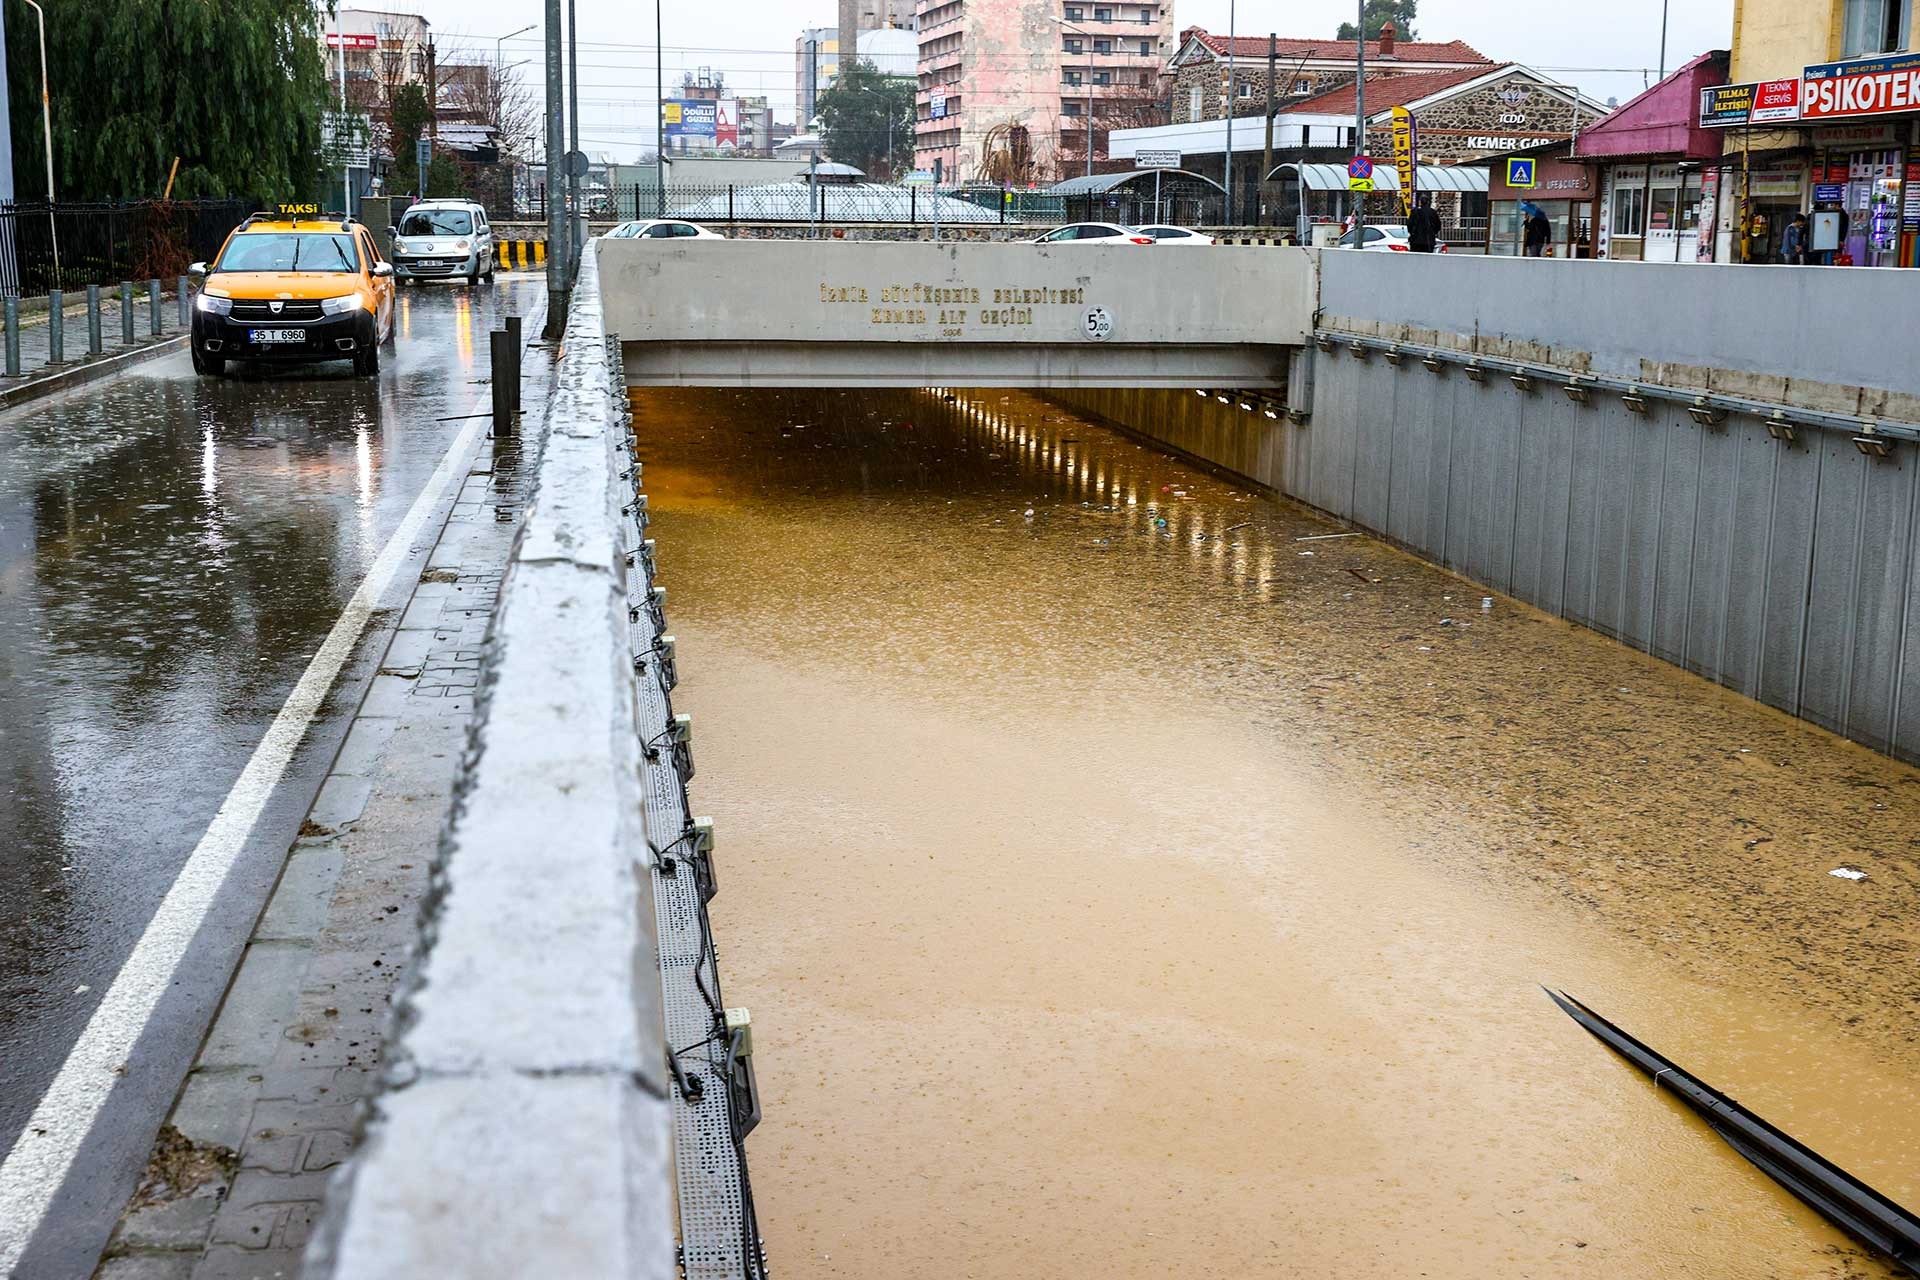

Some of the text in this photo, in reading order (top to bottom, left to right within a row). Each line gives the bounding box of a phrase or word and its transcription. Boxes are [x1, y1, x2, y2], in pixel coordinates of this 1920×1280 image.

[1765, 81, 1792, 93] TEKNİK
[1718, 88, 1750, 99] YILMAZ
[1763, 92, 1792, 104] SERVİS
[1499, 114, 1525, 124] TCDD
[1467, 136, 1516, 149] KEMER
[820, 283, 1084, 306] İZMİR BÜYÜKŞEHİR BELEDİYESİ
[872, 306, 1033, 327] KEMER ALT GEÇİDİ
[254, 330, 305, 340] 35 T 6960
